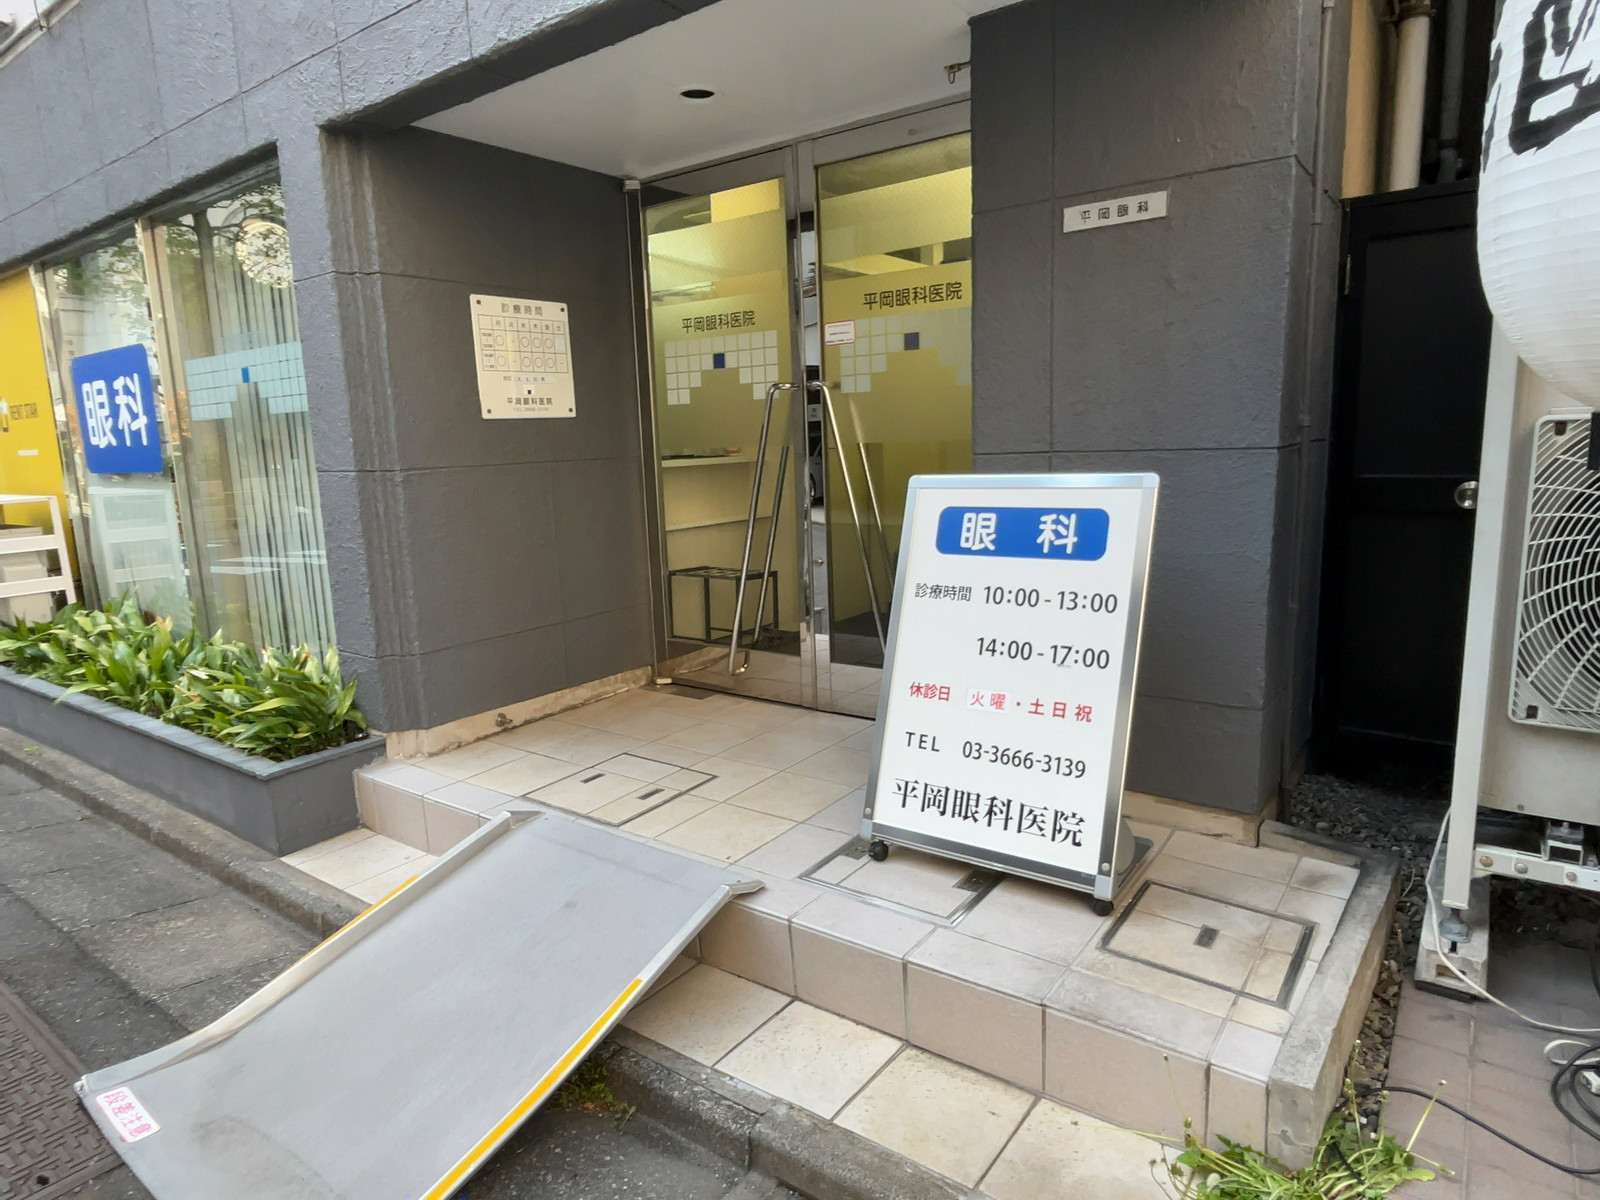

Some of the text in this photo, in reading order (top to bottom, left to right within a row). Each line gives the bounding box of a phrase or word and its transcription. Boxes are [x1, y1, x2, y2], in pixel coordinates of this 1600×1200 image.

[1079, 200, 1149, 224] 平岡眼科
[863, 281, 963, 310] 平岡眼科医院
[681, 310, 756, 334] 平岡眼科医院
[81, 372, 149, 449] 眼科
[959, 511, 1079, 556] 眼科
[914, 582, 972, 602] 診療時間
[909, 681, 951, 702] 休診日
[905, 731, 1086, 779] TEL 03-3666-3139
[892, 777, 1086, 848] 平岡眼科医院
